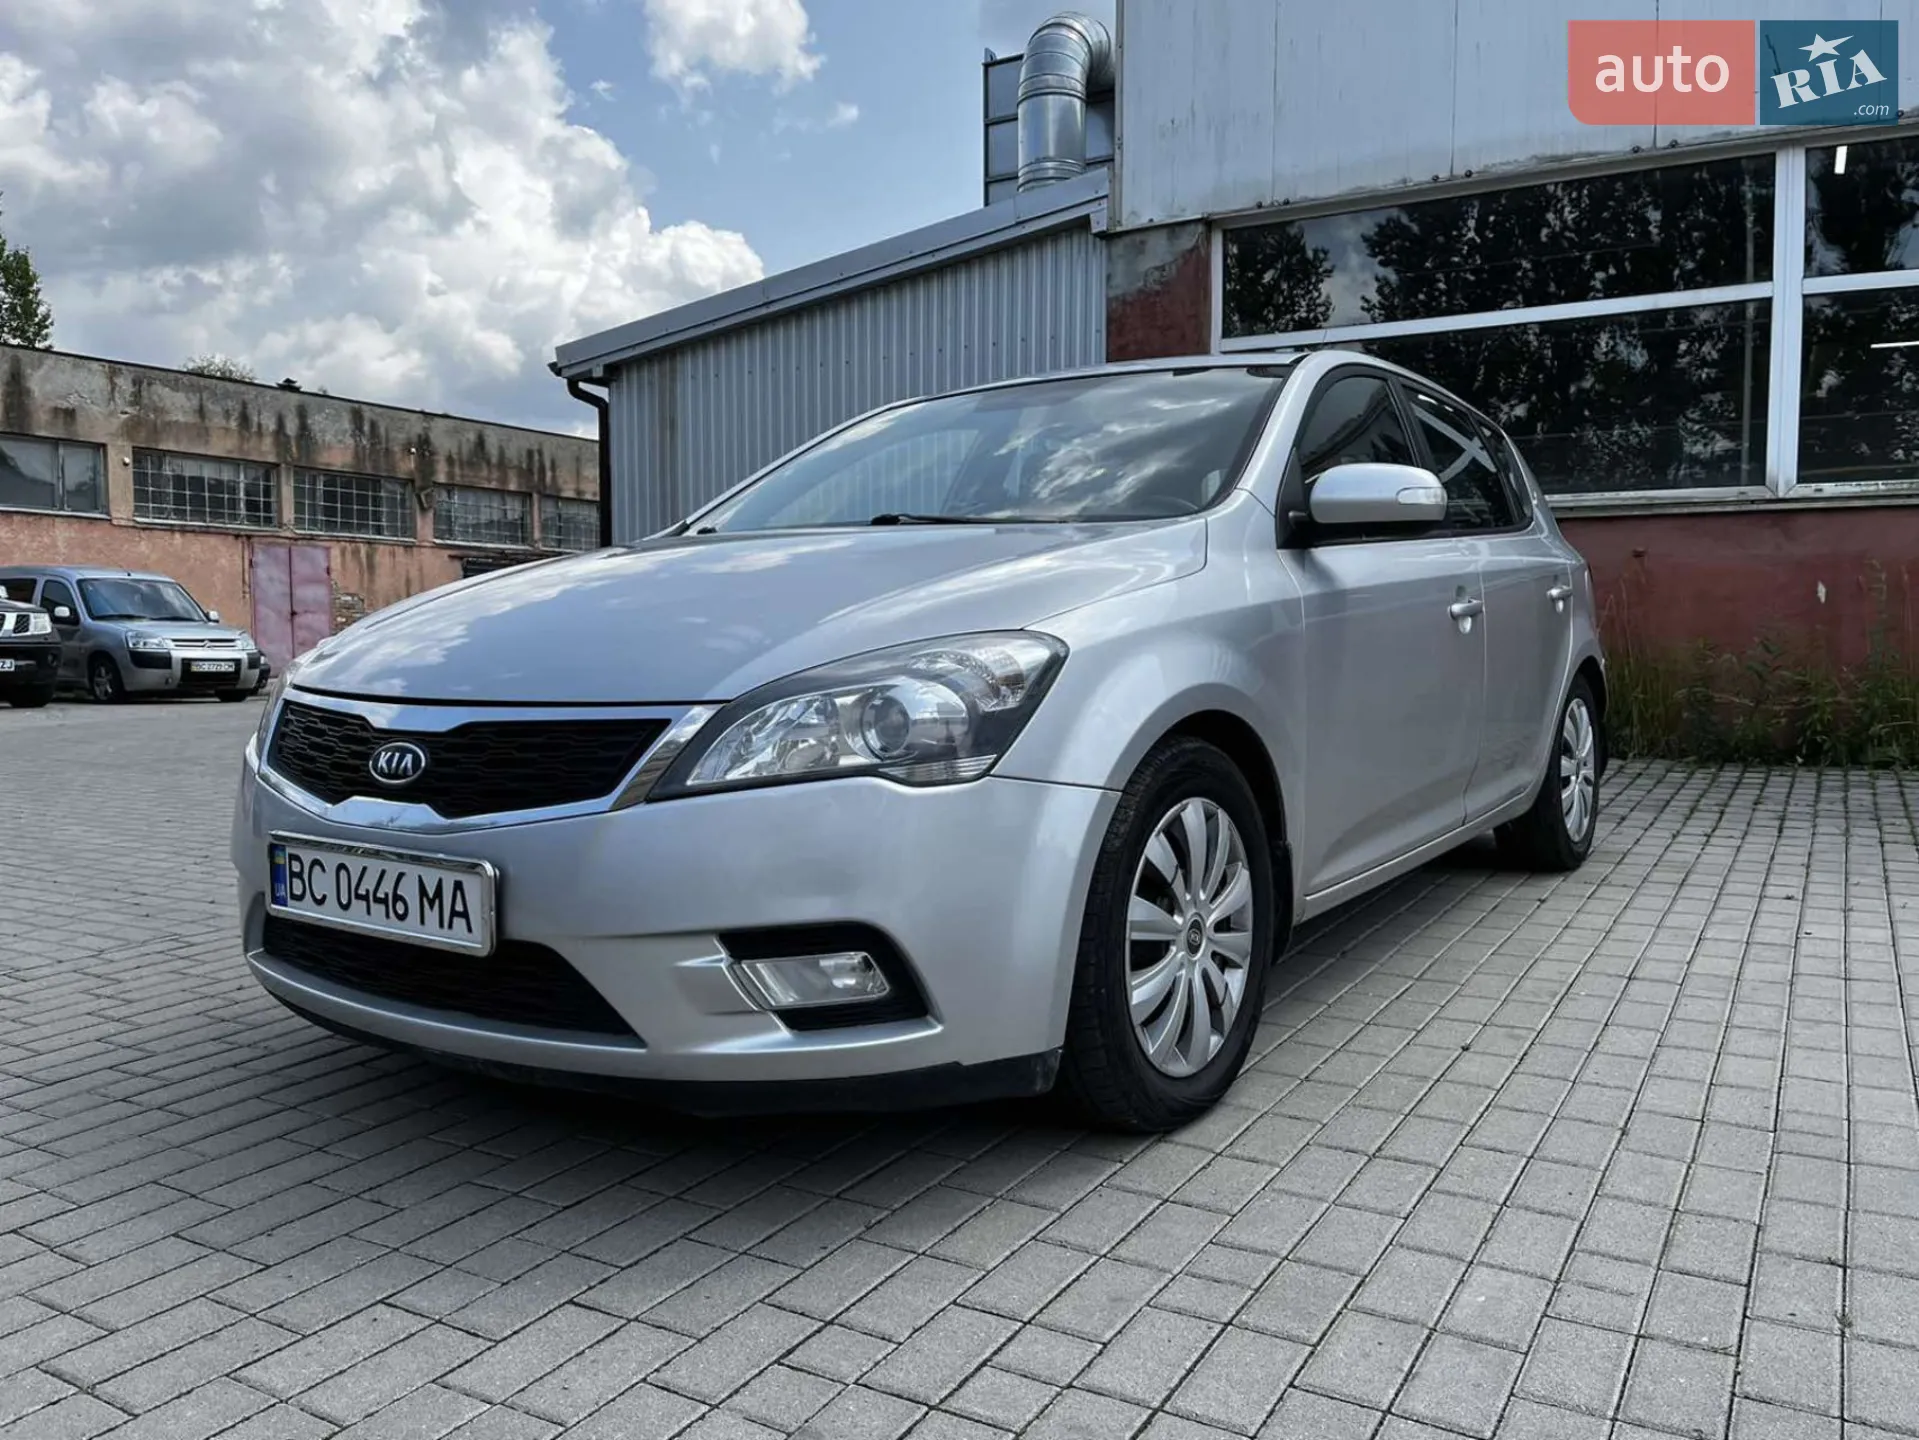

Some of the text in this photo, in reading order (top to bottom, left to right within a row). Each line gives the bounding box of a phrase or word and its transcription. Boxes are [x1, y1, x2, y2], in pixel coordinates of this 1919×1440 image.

[377, 751, 413, 775] KIA
[288, 853, 473, 934] BC 0446 MA
